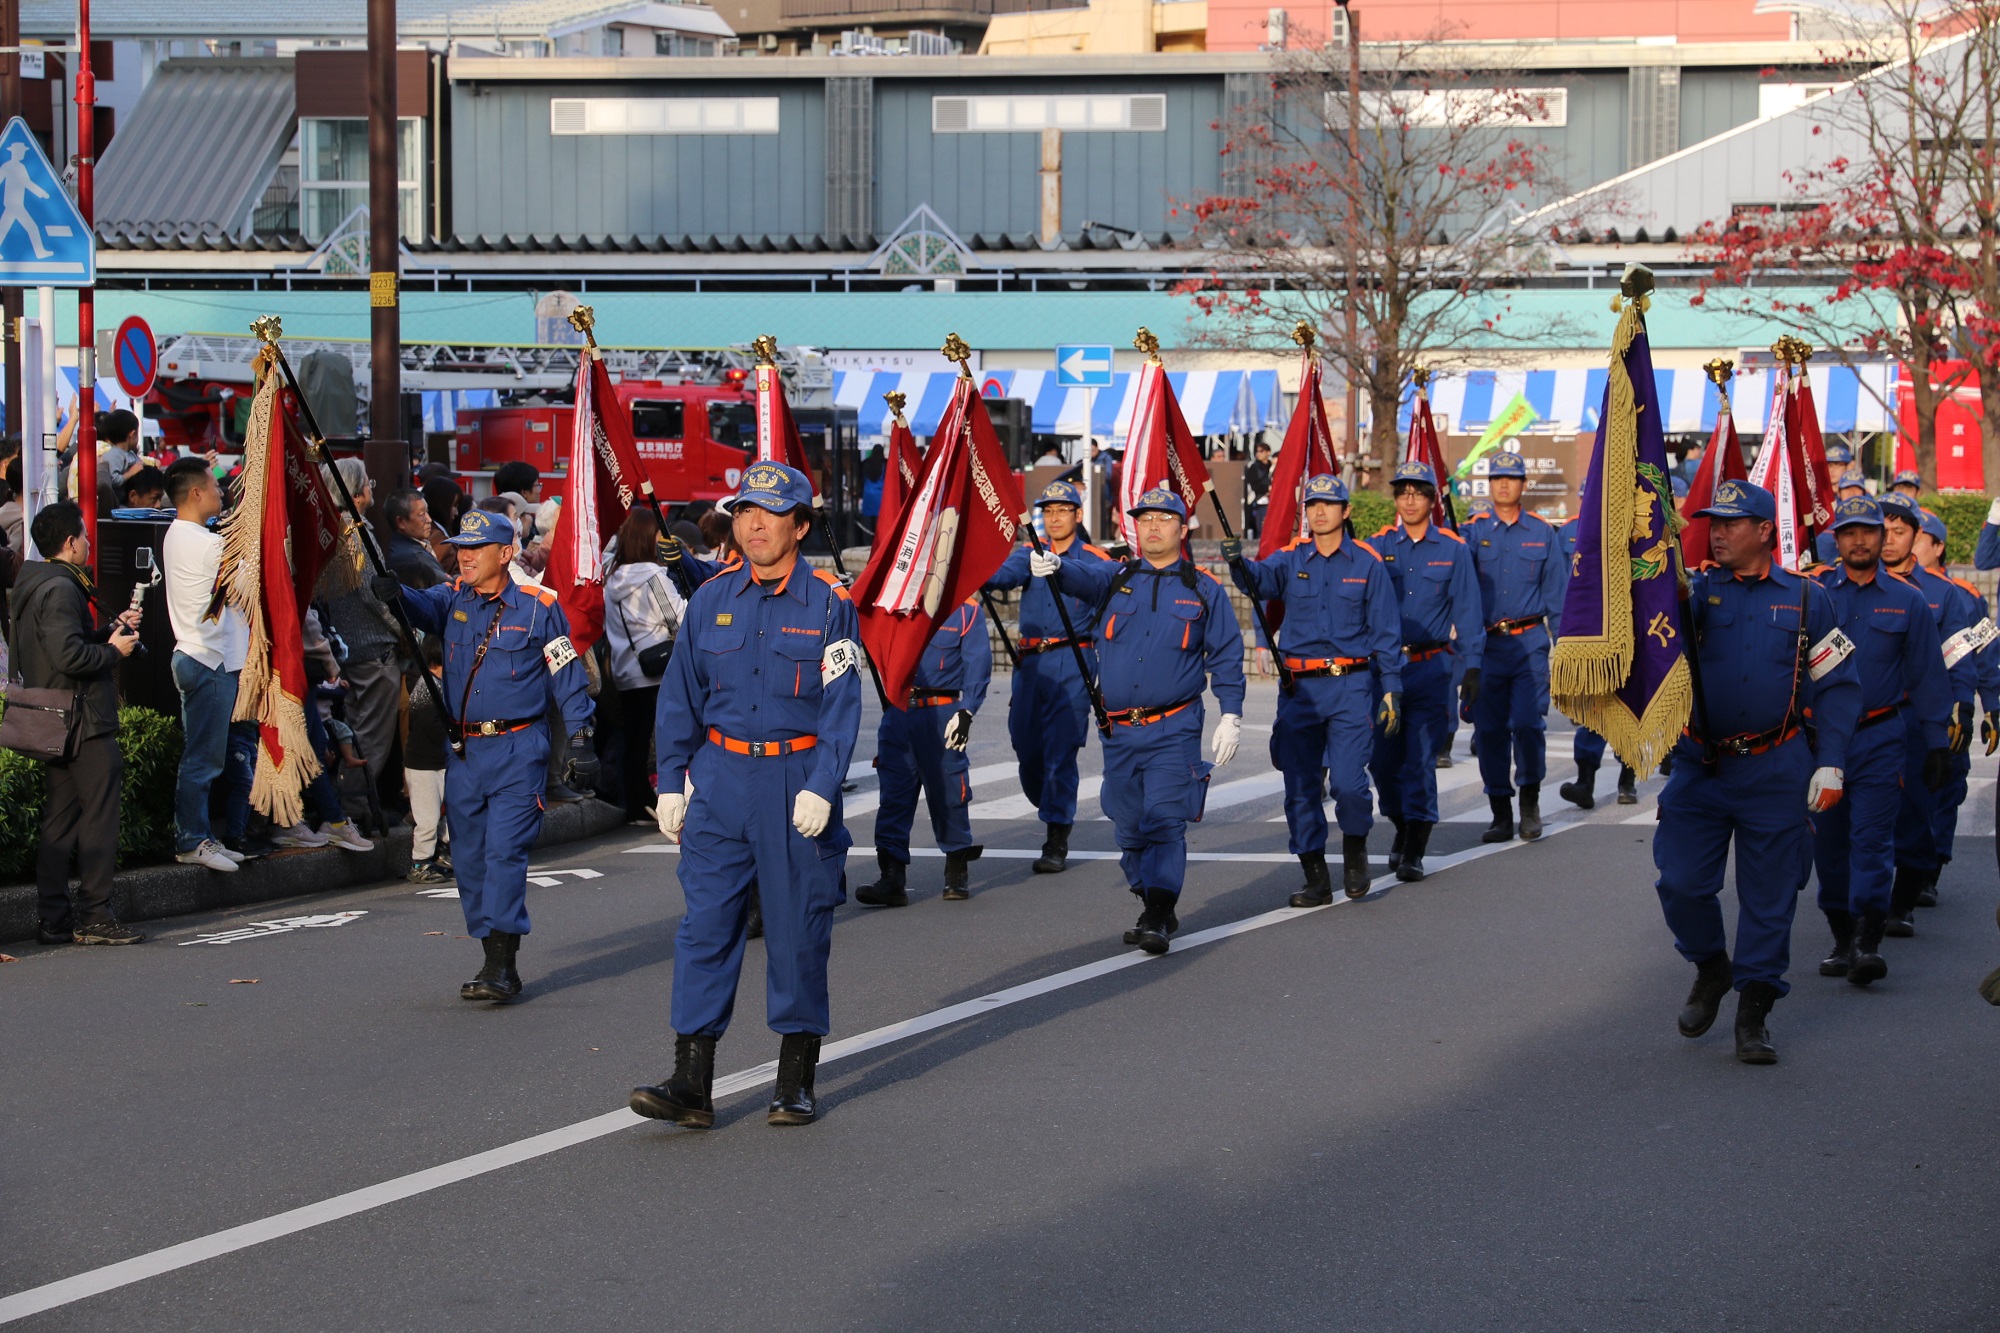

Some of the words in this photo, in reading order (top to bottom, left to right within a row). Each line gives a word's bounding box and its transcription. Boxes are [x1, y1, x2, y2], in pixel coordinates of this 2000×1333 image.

[896, 531, 918, 573] 三消連
[1781, 518, 1794, 554] 三消連
